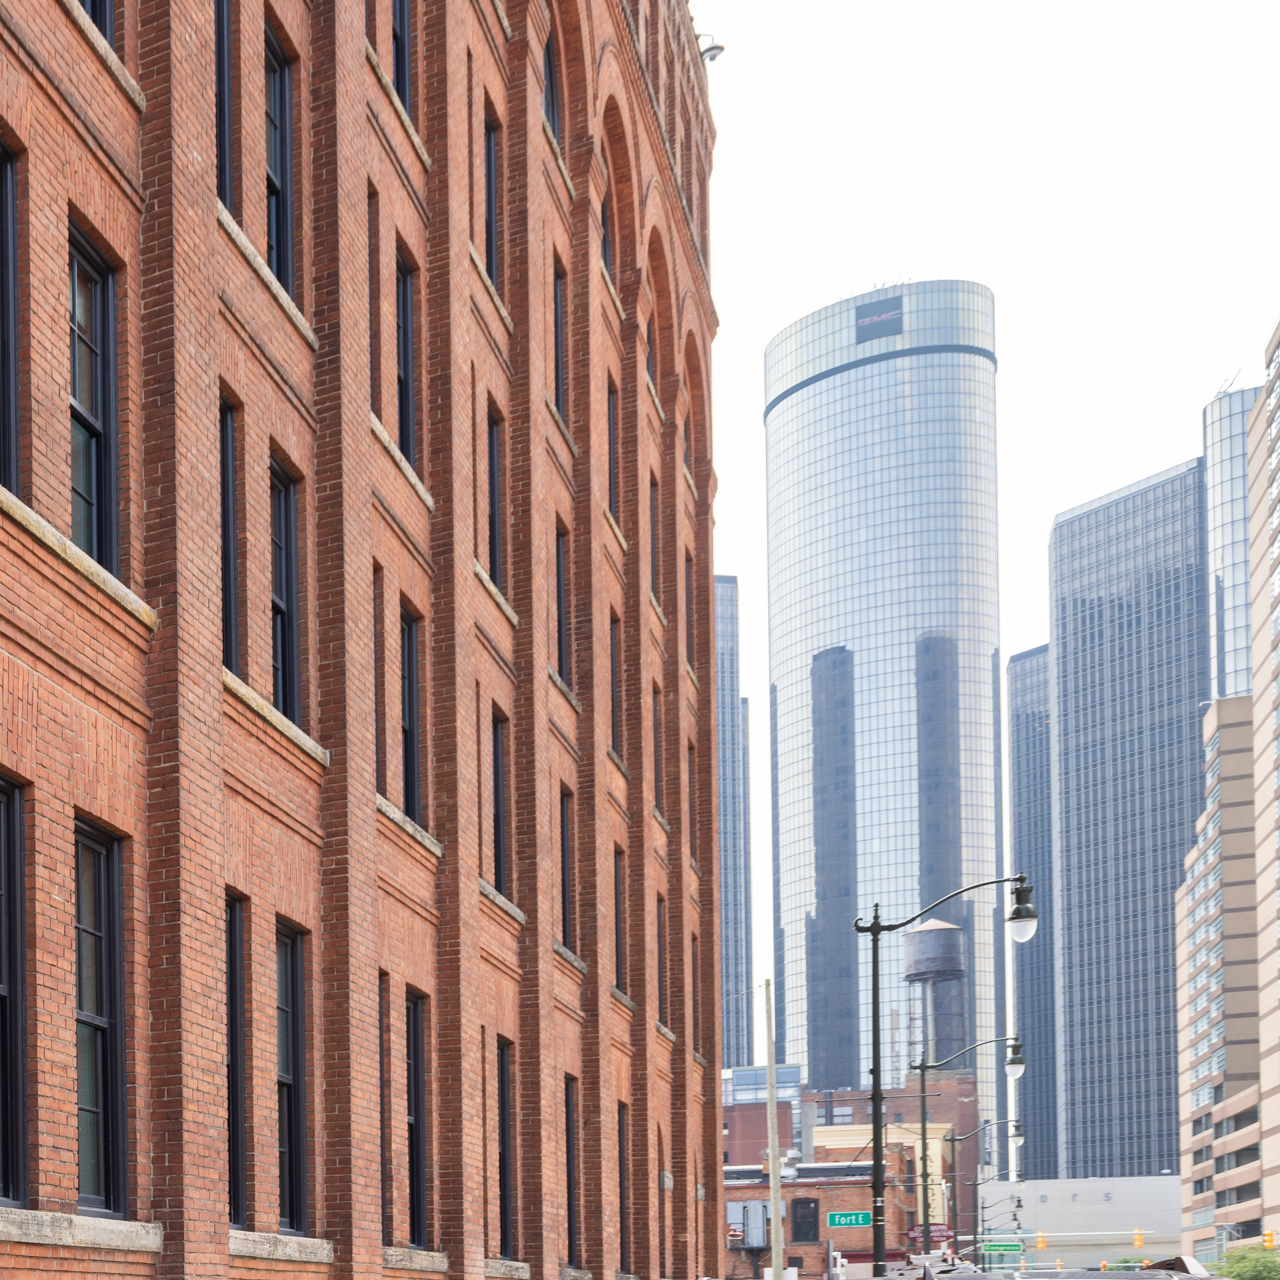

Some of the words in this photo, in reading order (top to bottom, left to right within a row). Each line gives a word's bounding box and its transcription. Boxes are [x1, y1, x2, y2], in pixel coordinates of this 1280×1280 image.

[857, 310, 902, 327] GMC
[835, 1214, 857, 1224] Fort
[858, 1214, 864, 1224] E
